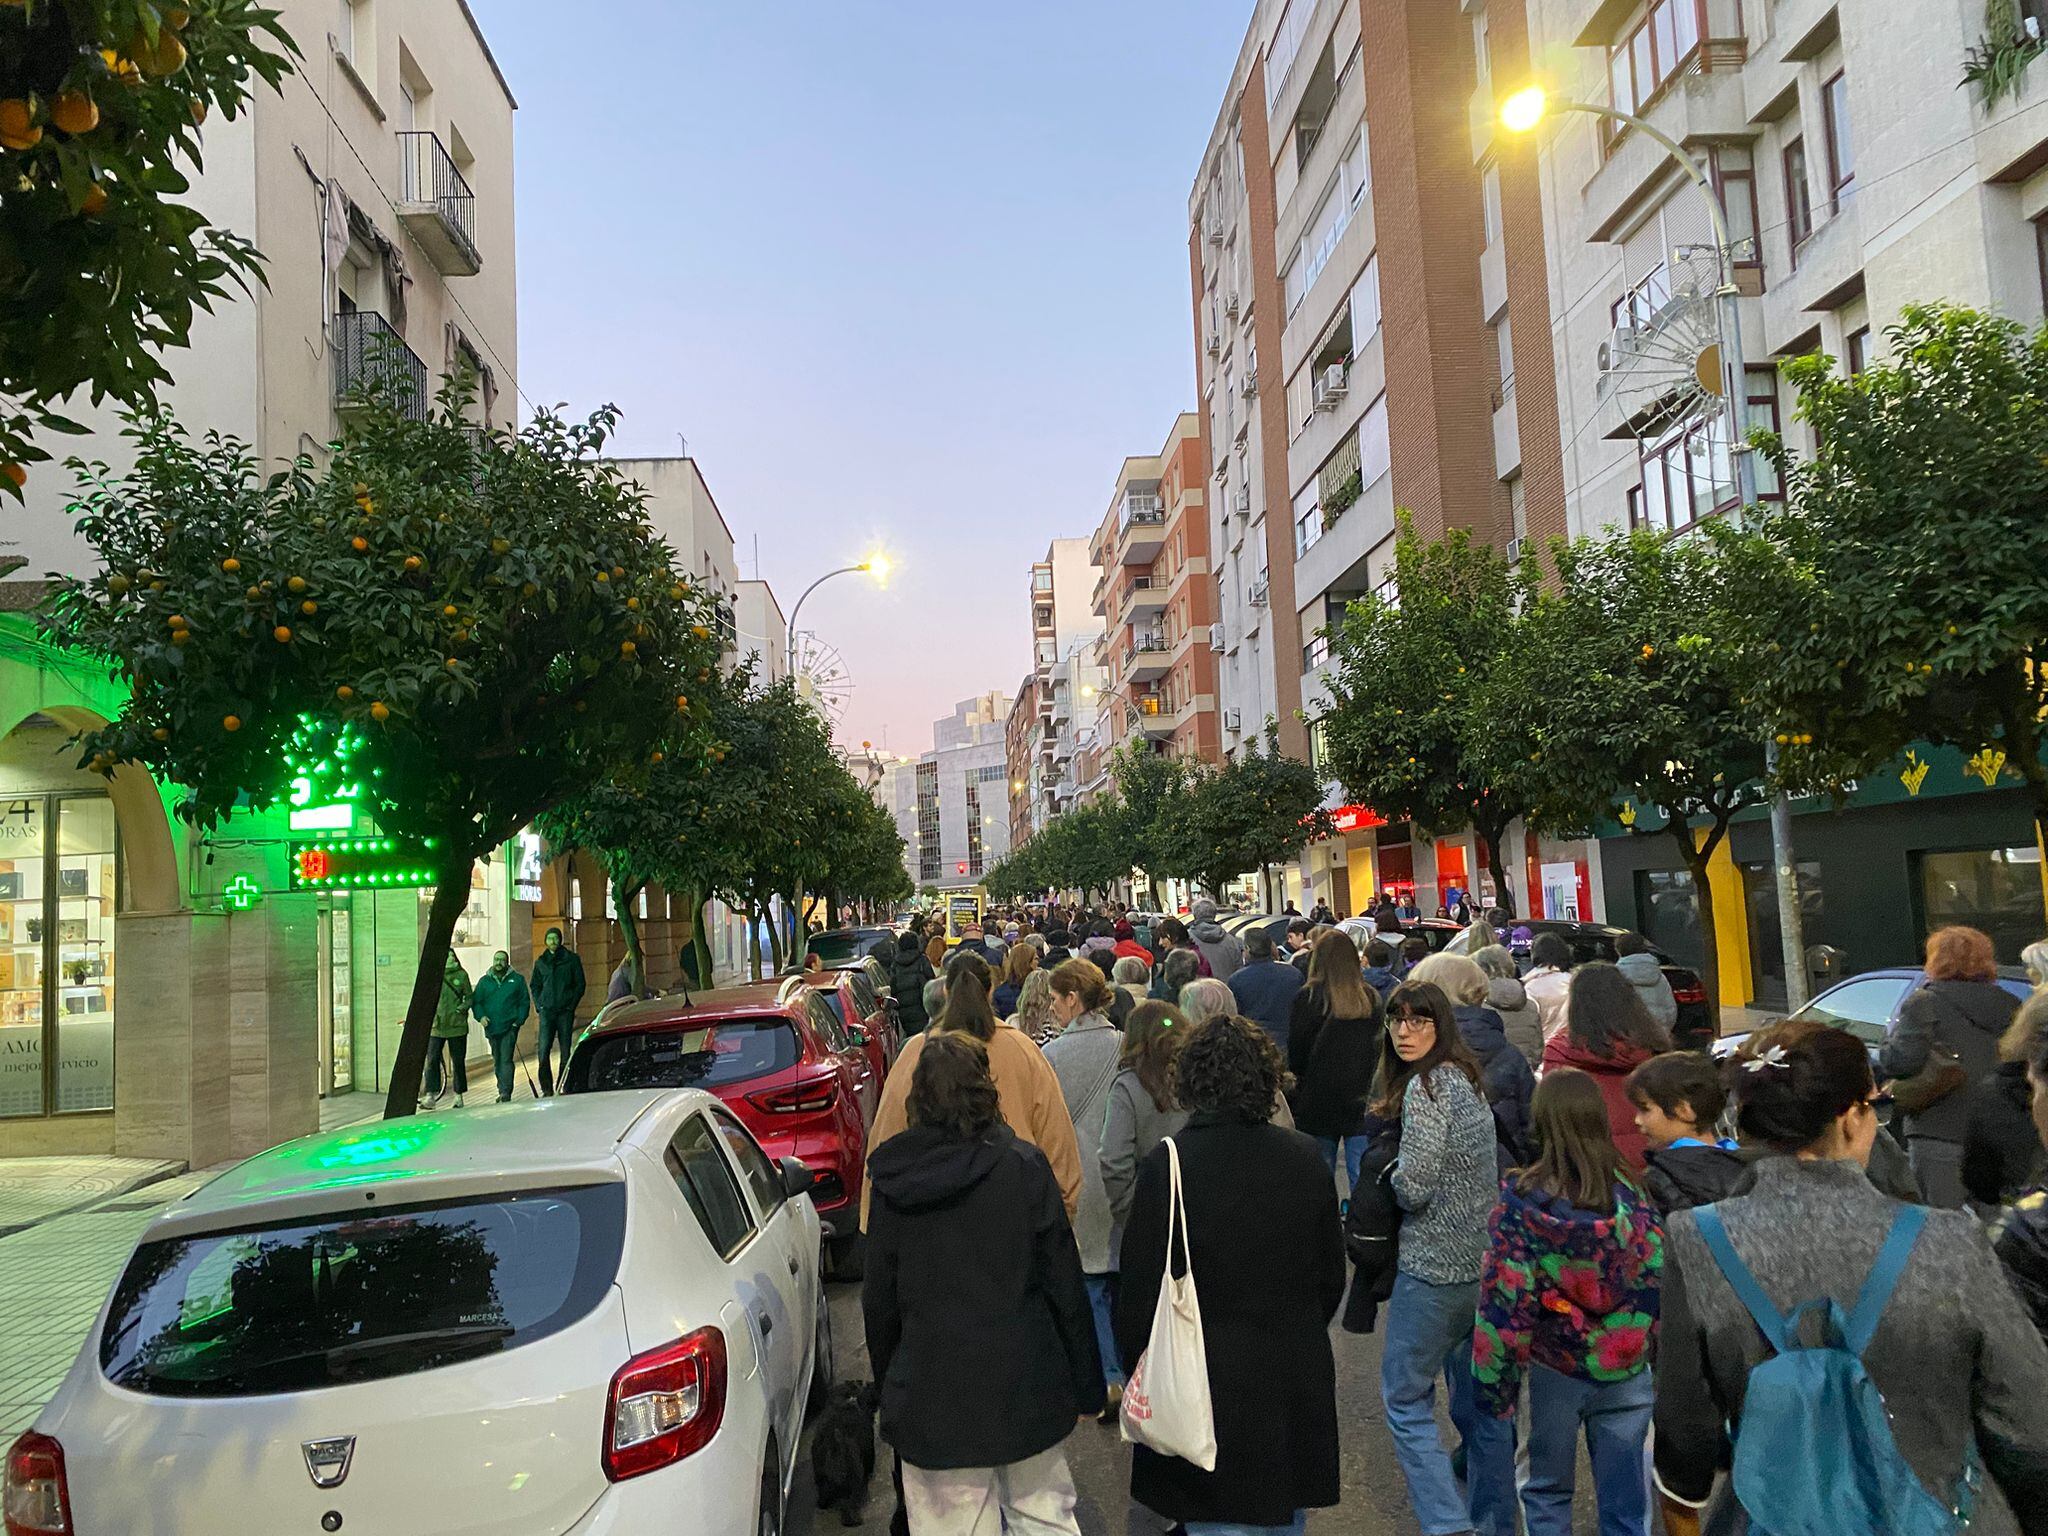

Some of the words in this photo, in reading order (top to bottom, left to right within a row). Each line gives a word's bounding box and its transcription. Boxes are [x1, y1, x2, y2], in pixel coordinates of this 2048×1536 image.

[59, 1056, 99, 1069] rvicio
[459, 1312, 498, 1323] MARCESA
[310, 1446, 346, 1456] DACIA
